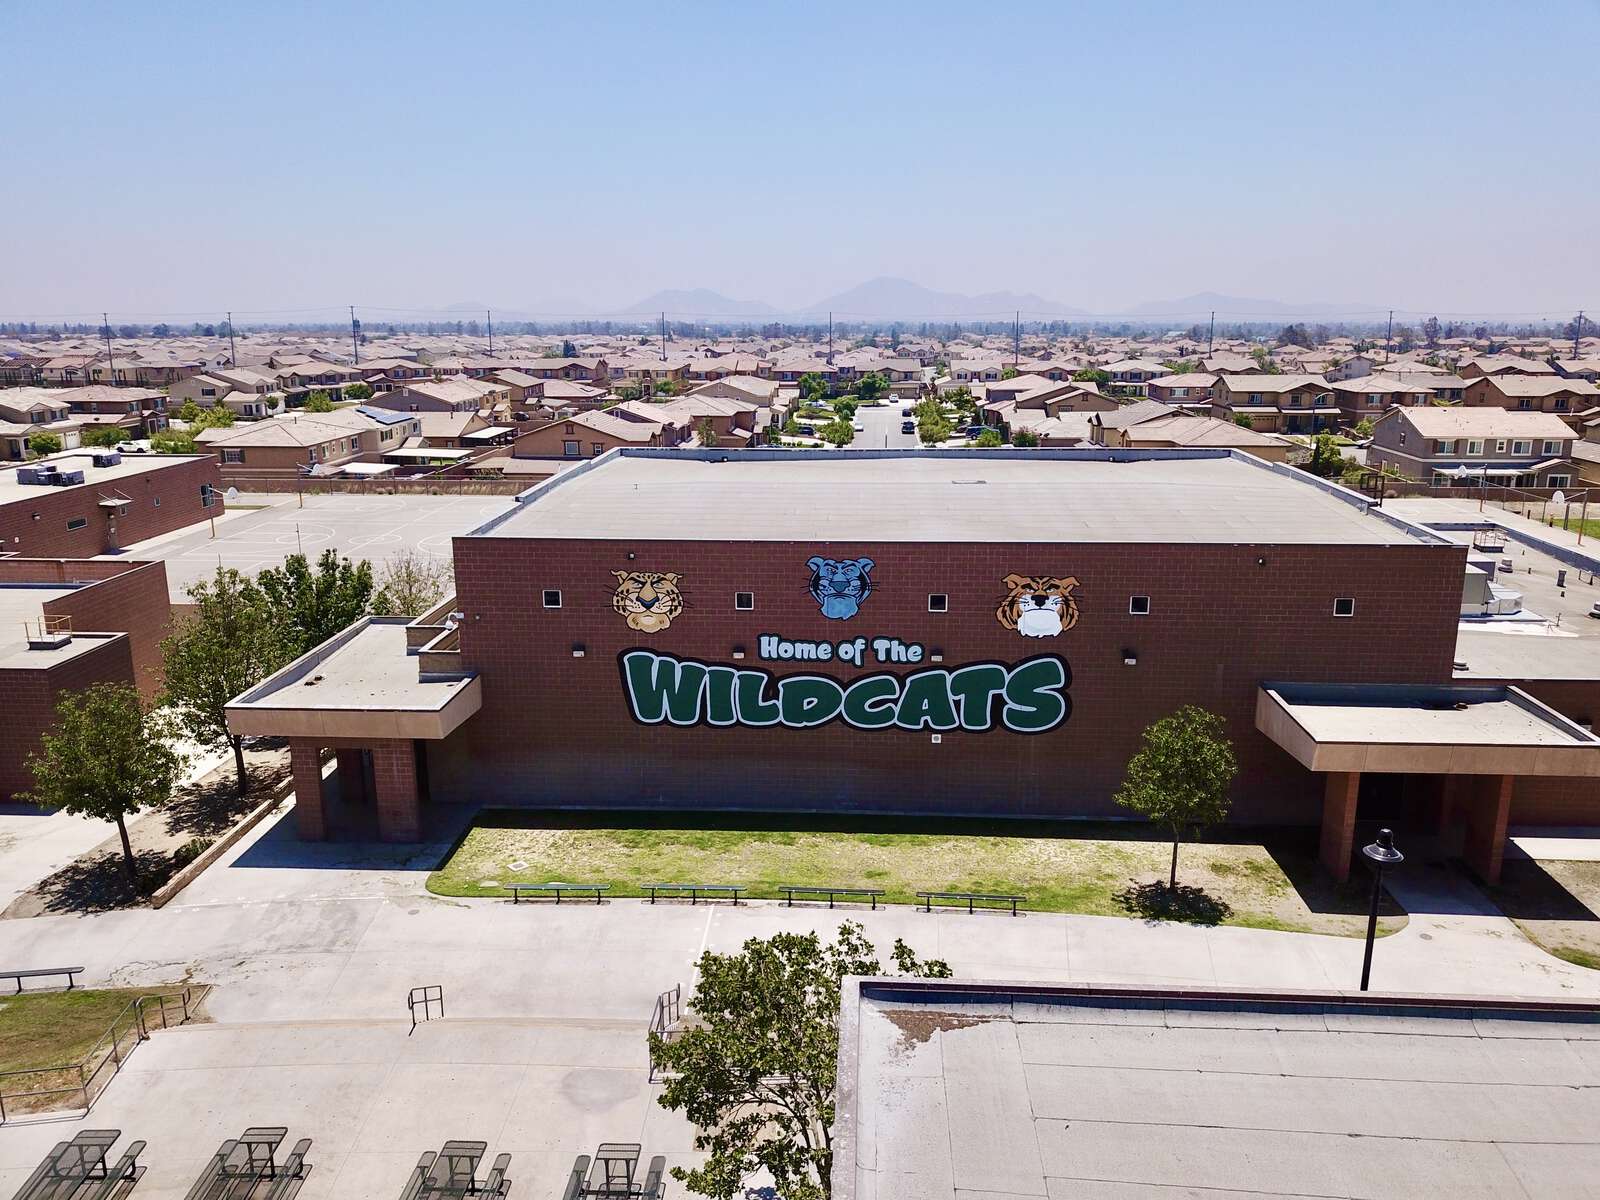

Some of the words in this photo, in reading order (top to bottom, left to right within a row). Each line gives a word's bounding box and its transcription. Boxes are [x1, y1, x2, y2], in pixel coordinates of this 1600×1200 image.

[761, 636, 831, 661] Home
[838, 637, 866, 666] of
[873, 639, 923, 663] The
[623, 651, 1066, 731] WILDCATS
